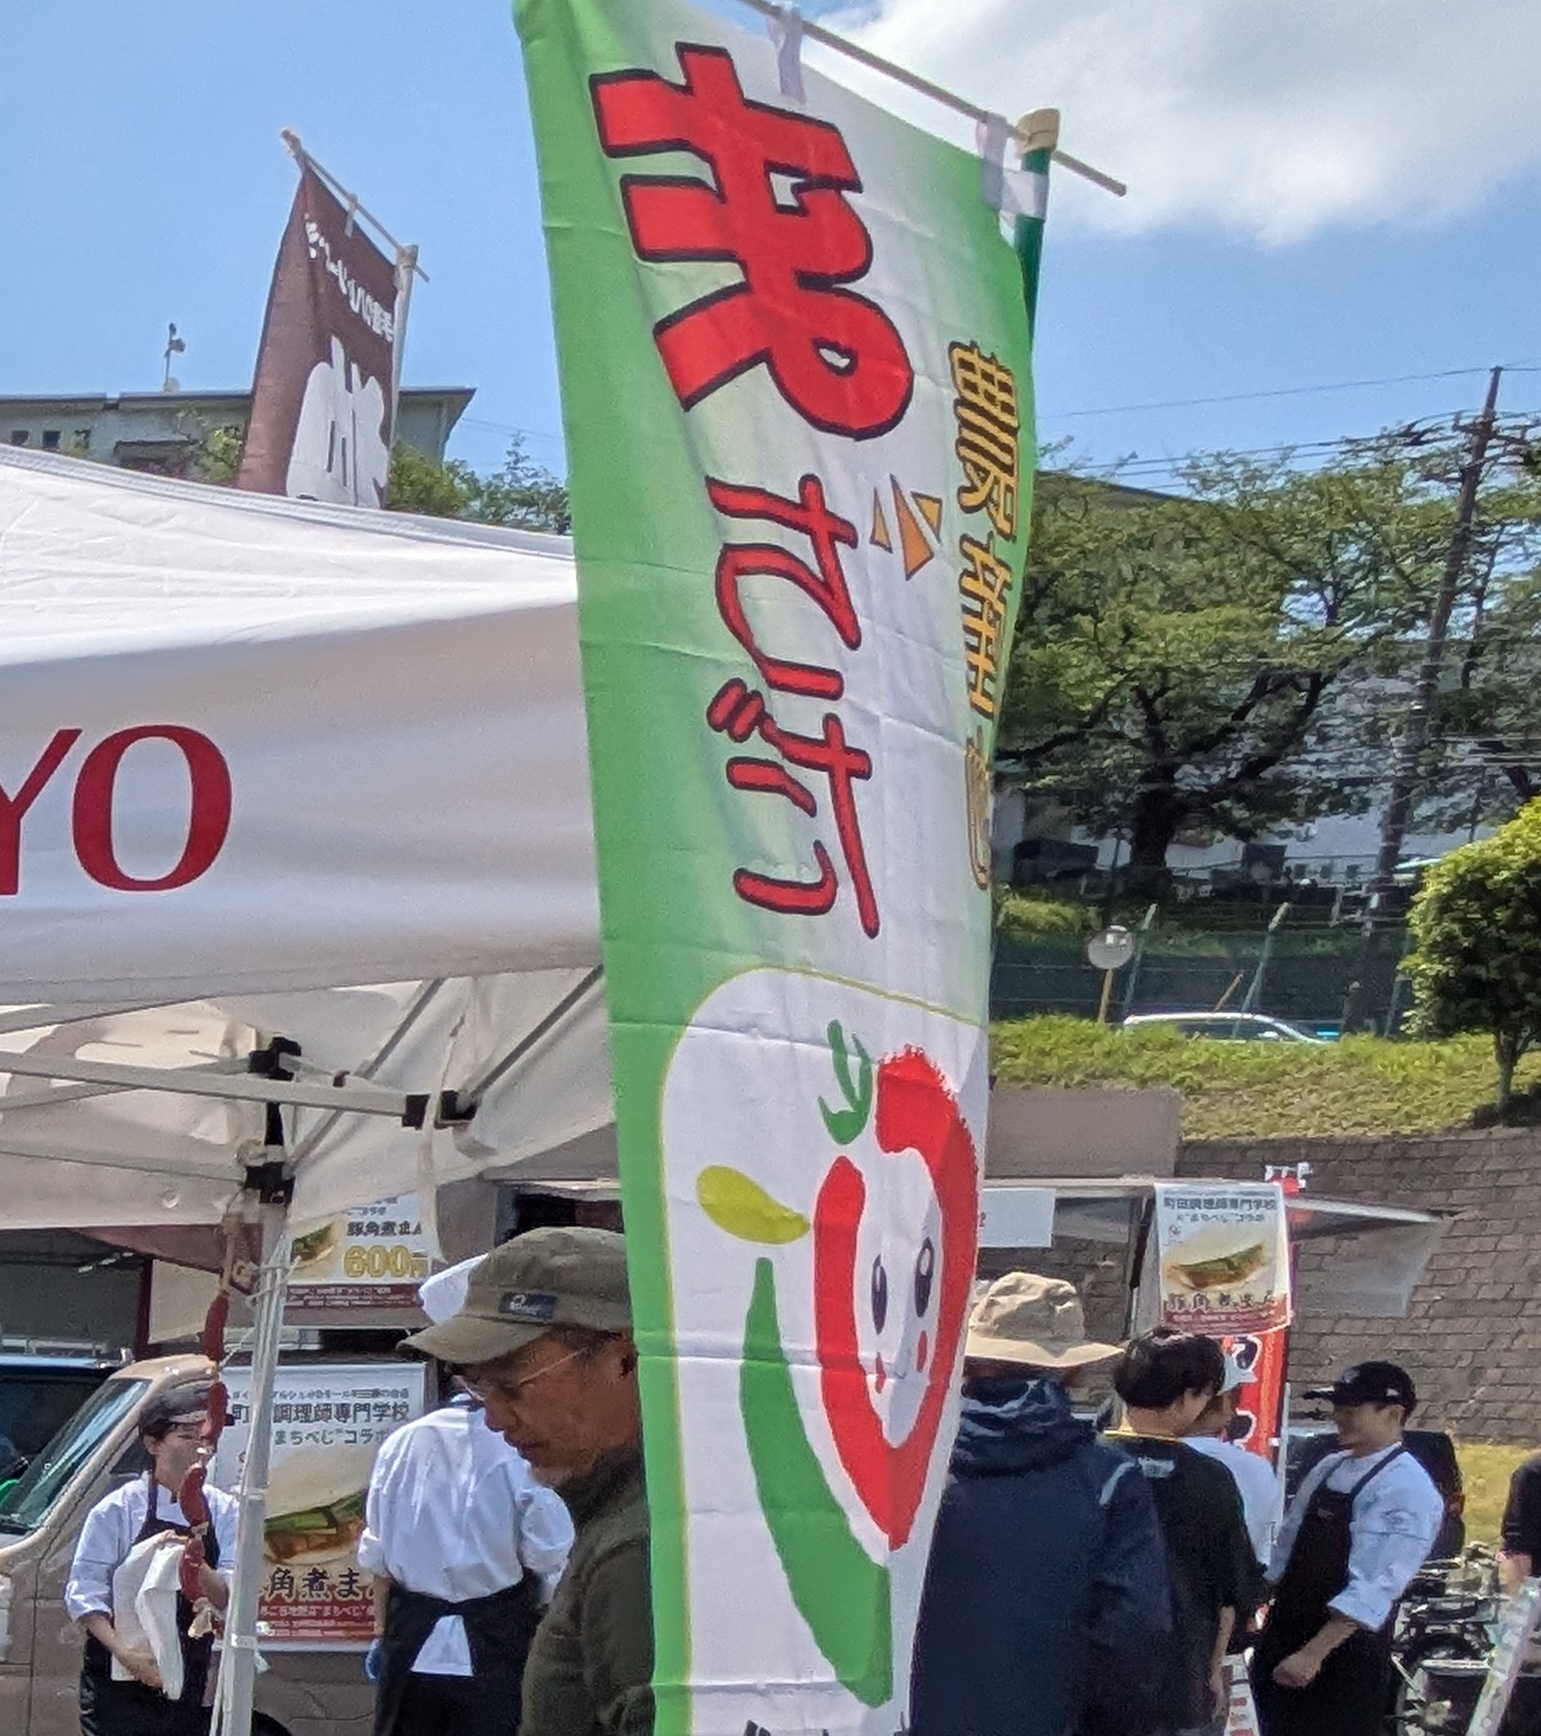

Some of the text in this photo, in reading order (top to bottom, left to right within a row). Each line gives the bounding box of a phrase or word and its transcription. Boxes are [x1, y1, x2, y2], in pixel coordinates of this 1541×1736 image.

[232, 1402, 409, 1424] 町調理師専門学校
[267, 1566, 365, 1600] 角煮ま
